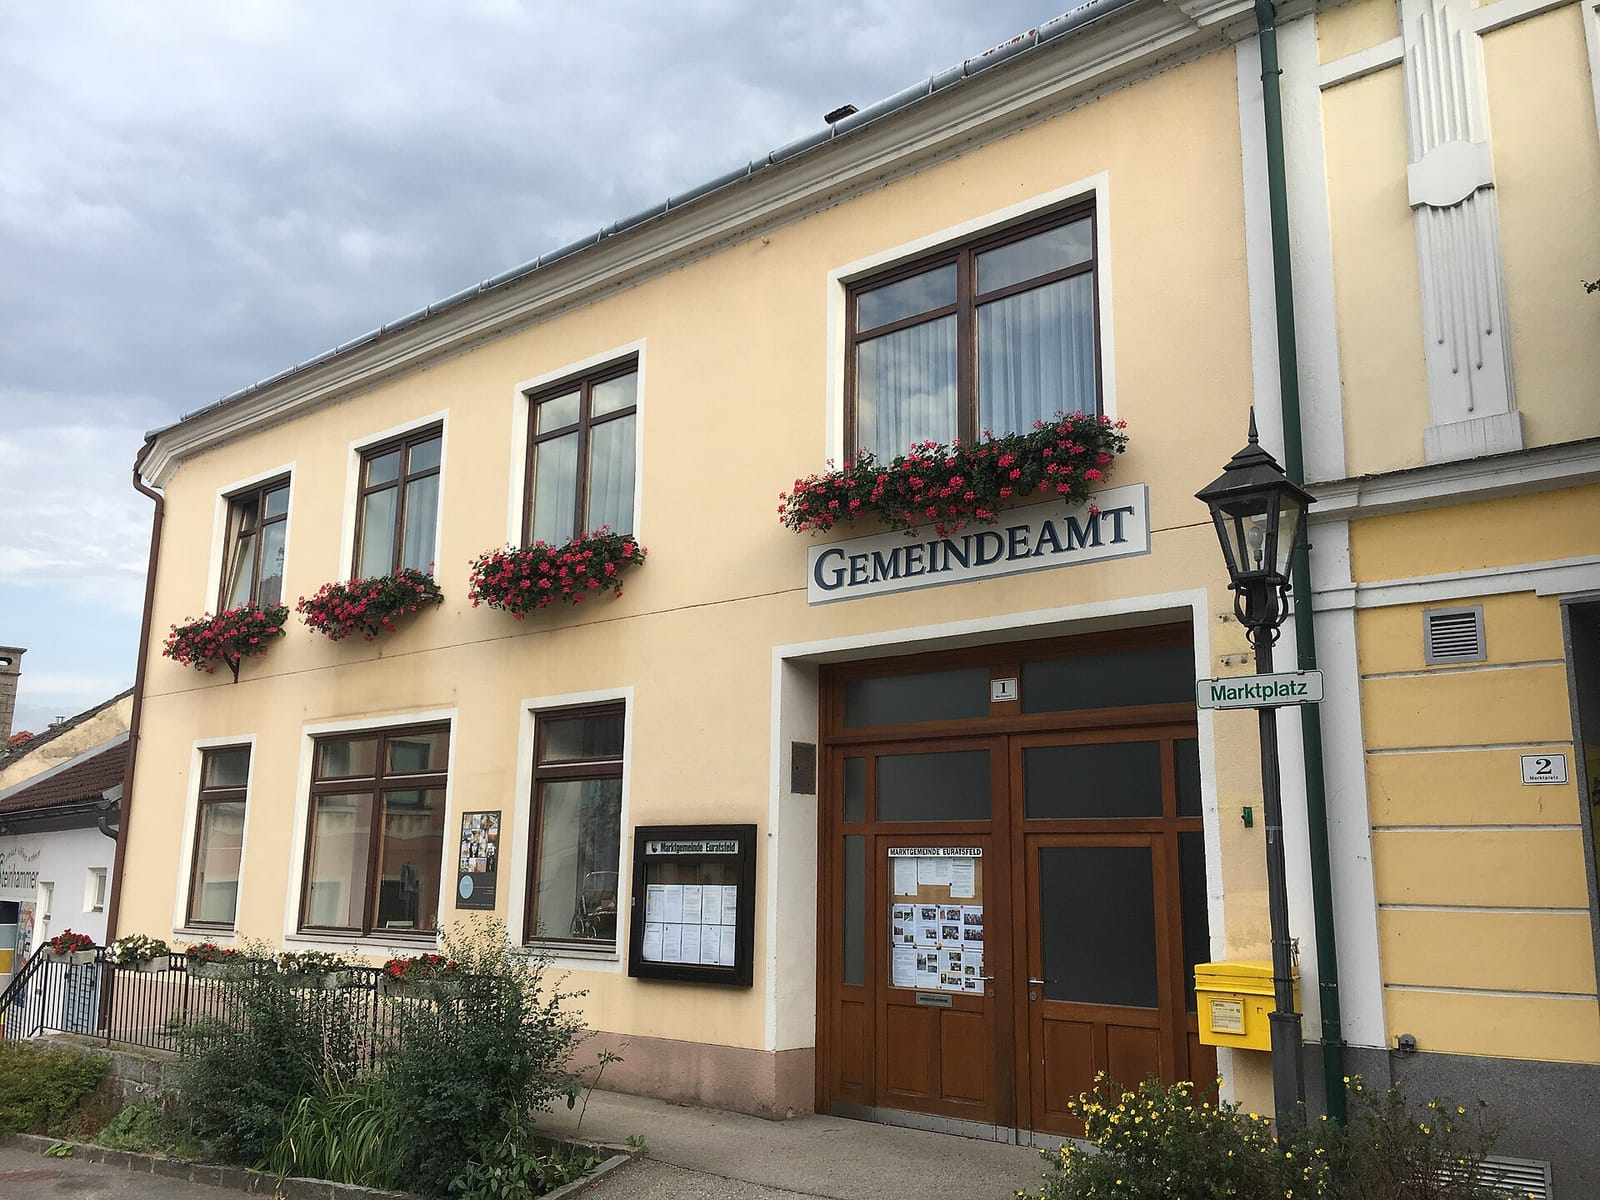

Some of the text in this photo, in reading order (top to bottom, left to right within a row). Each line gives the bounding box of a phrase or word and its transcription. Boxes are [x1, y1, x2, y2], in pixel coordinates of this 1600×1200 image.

[813, 505, 1135, 591] GEMEINDEAMT
[1000, 682, 1007, 694] 1
[1211, 681, 1308, 701] Marktplatz
[1536, 758, 1552, 775] 2
[660, 842, 736, 854] Marktgemeinde Euratsfeld
[889, 848, 982, 856] MARKTGEMEINDE EURATSFELD
